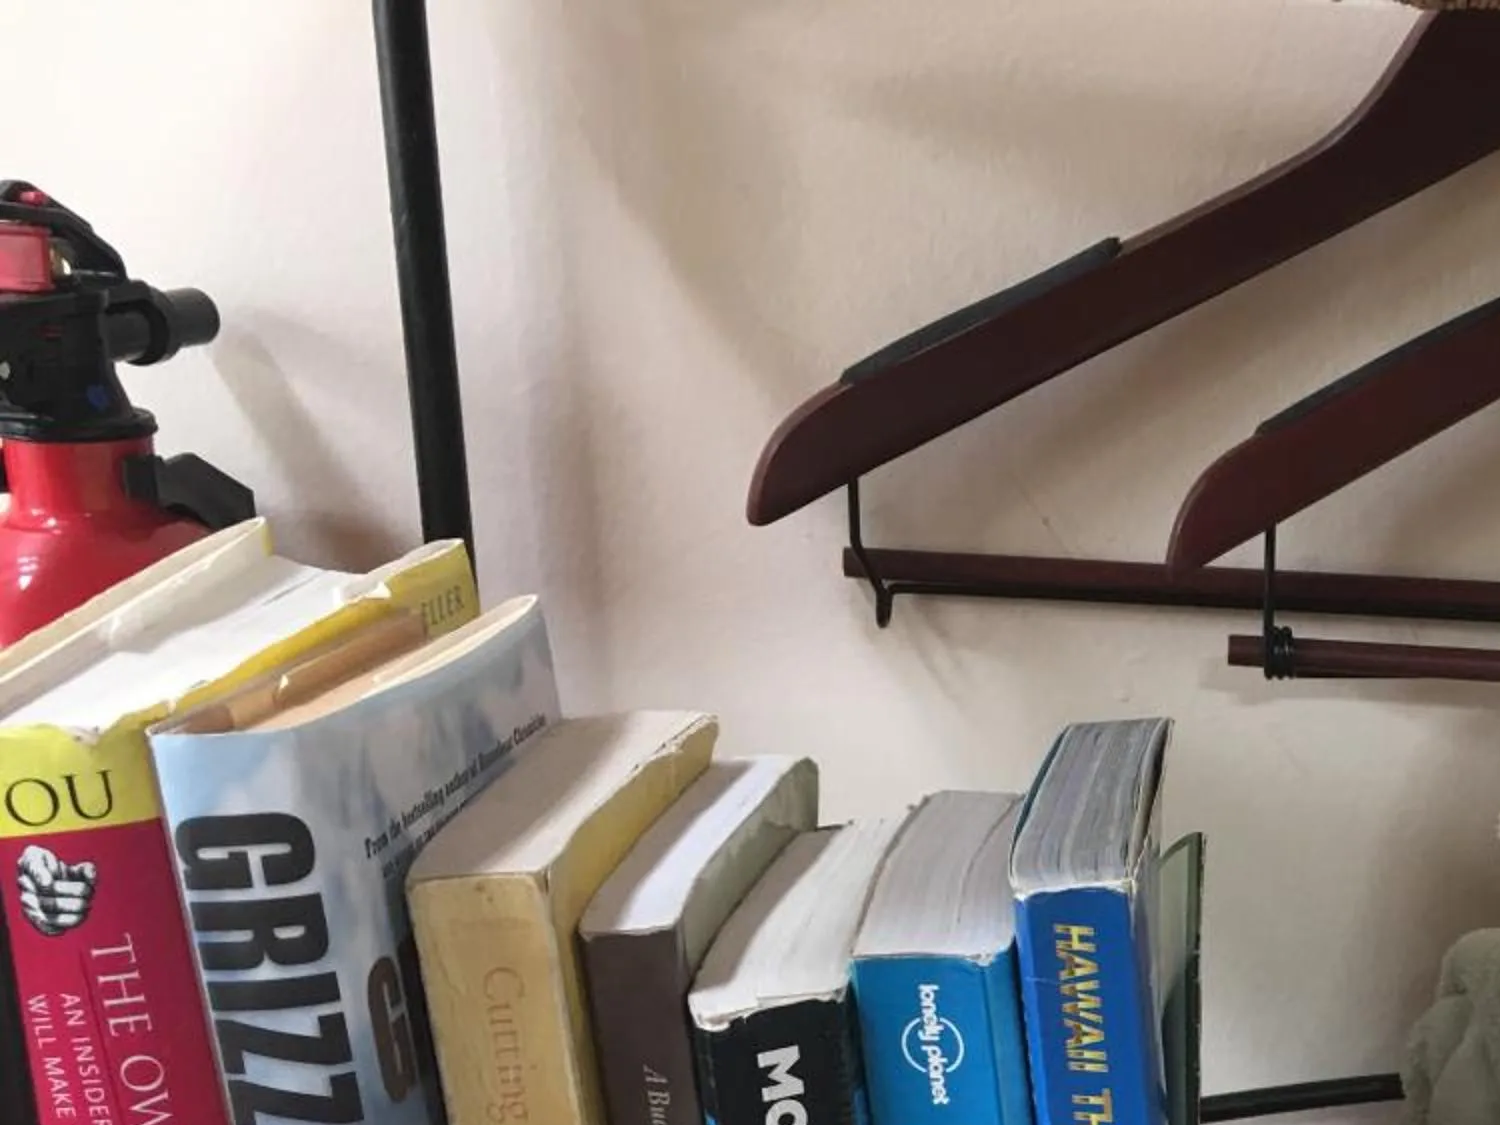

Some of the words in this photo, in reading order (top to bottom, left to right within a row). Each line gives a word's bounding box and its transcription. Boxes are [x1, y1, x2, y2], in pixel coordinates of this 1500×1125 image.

[59, 993, 83, 1027] AN
[90, 932, 152, 1037] THE
[918, 984, 944, 1040] lonely
[1054, 923, 1109, 1073] HAWAII
[27, 994, 57, 1049] WILL
[43, 1057, 76, 1118] MAKE
[483, 966, 537, 1125] Cutting
[643, 1064, 668, 1084] A
[921, 1045, 950, 1104] planet
